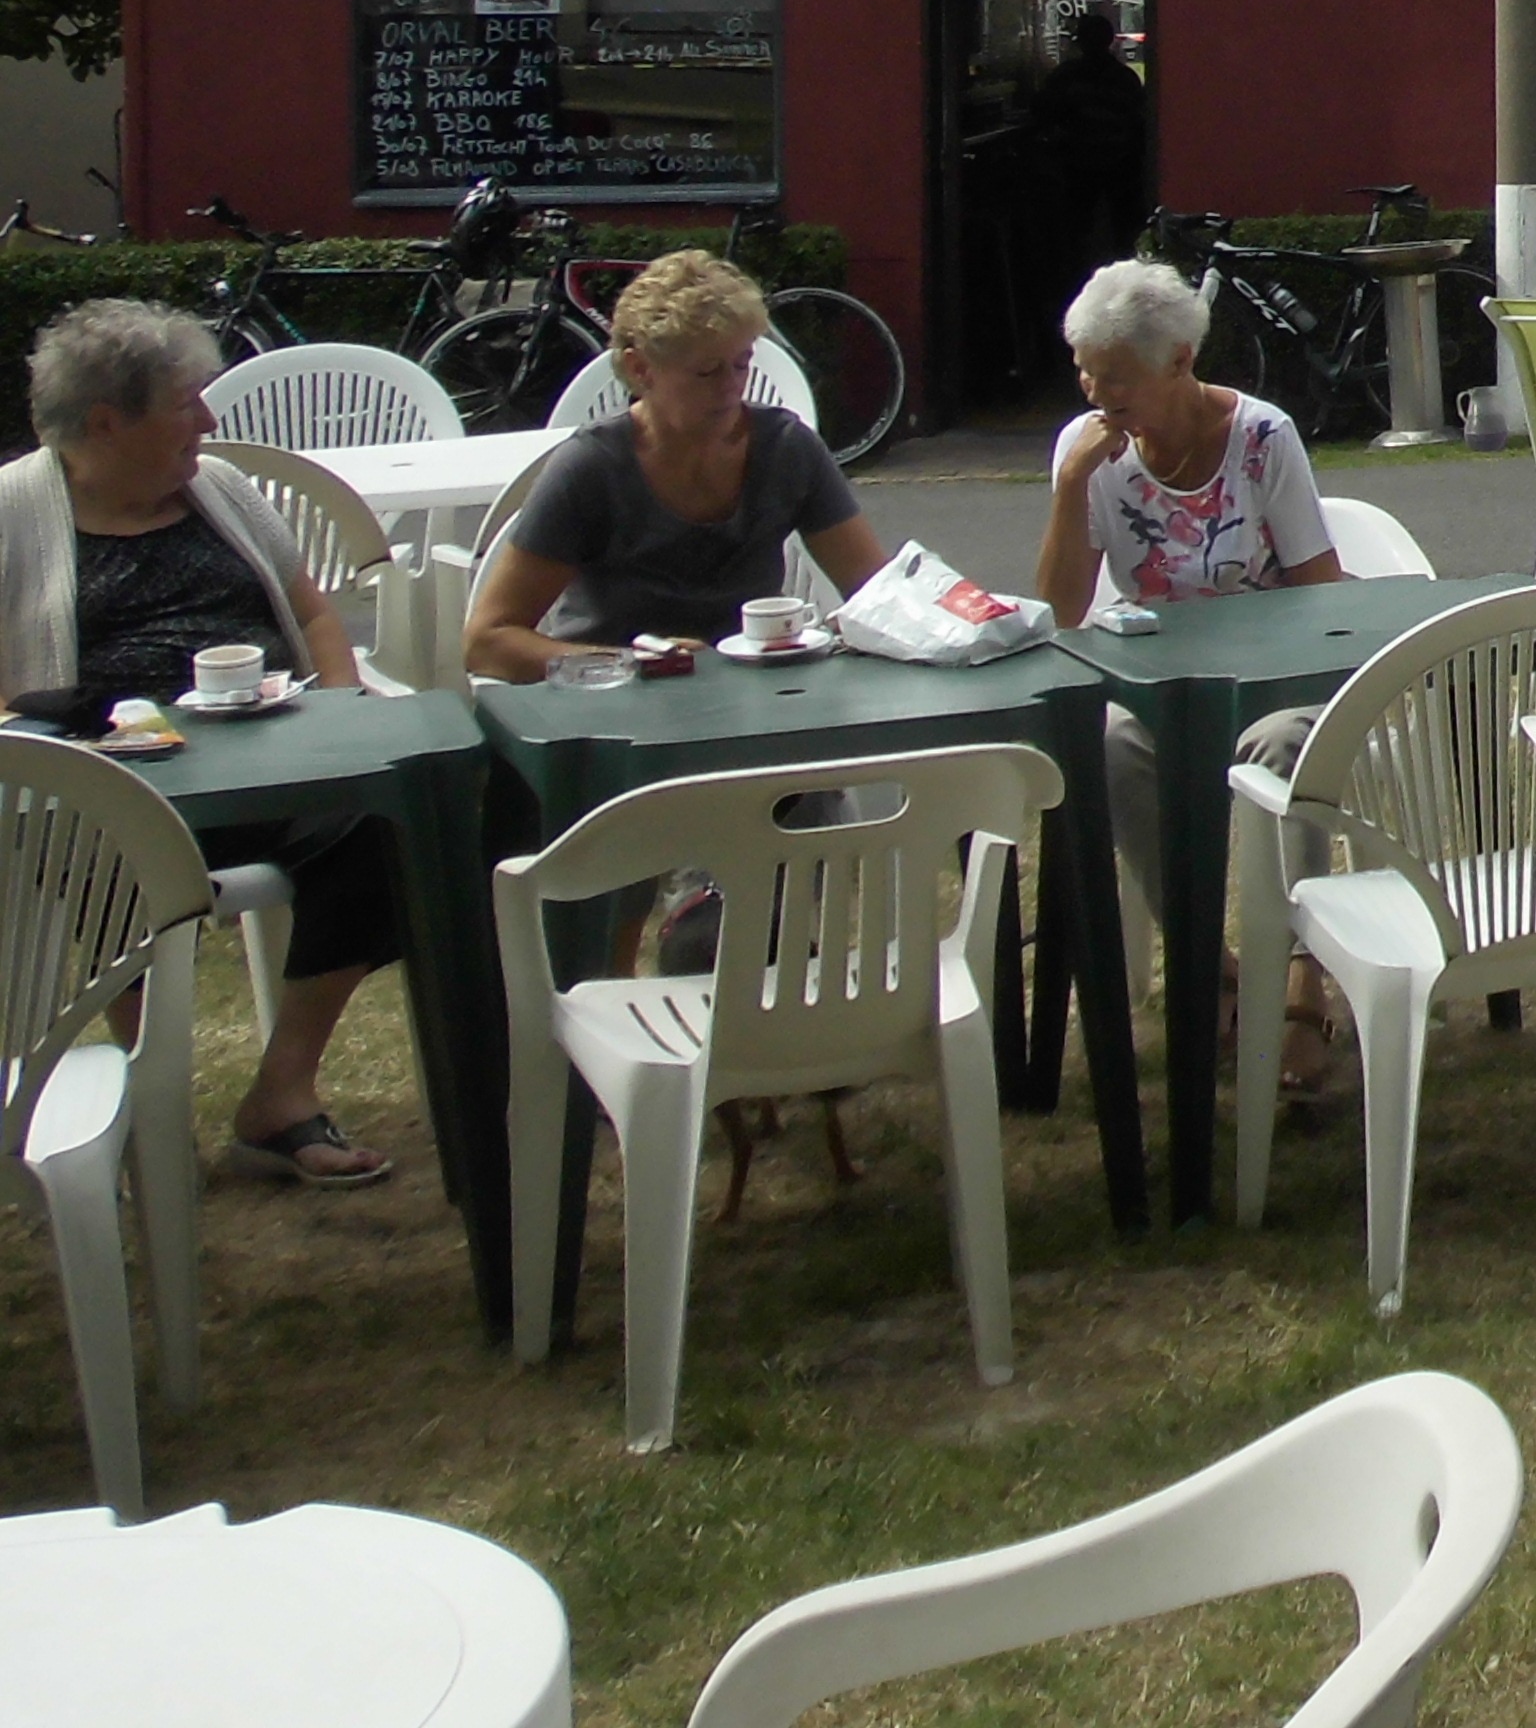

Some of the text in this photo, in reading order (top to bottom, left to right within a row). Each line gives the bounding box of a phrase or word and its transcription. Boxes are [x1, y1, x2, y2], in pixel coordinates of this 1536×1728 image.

[381, 20, 467, 48] ORVAL
[485, 17, 557, 44] BEER
[429, 46, 500, 68] HAPPY
[426, 90, 522, 110] KARAOKE
[433, 113, 492, 133] BBQ
